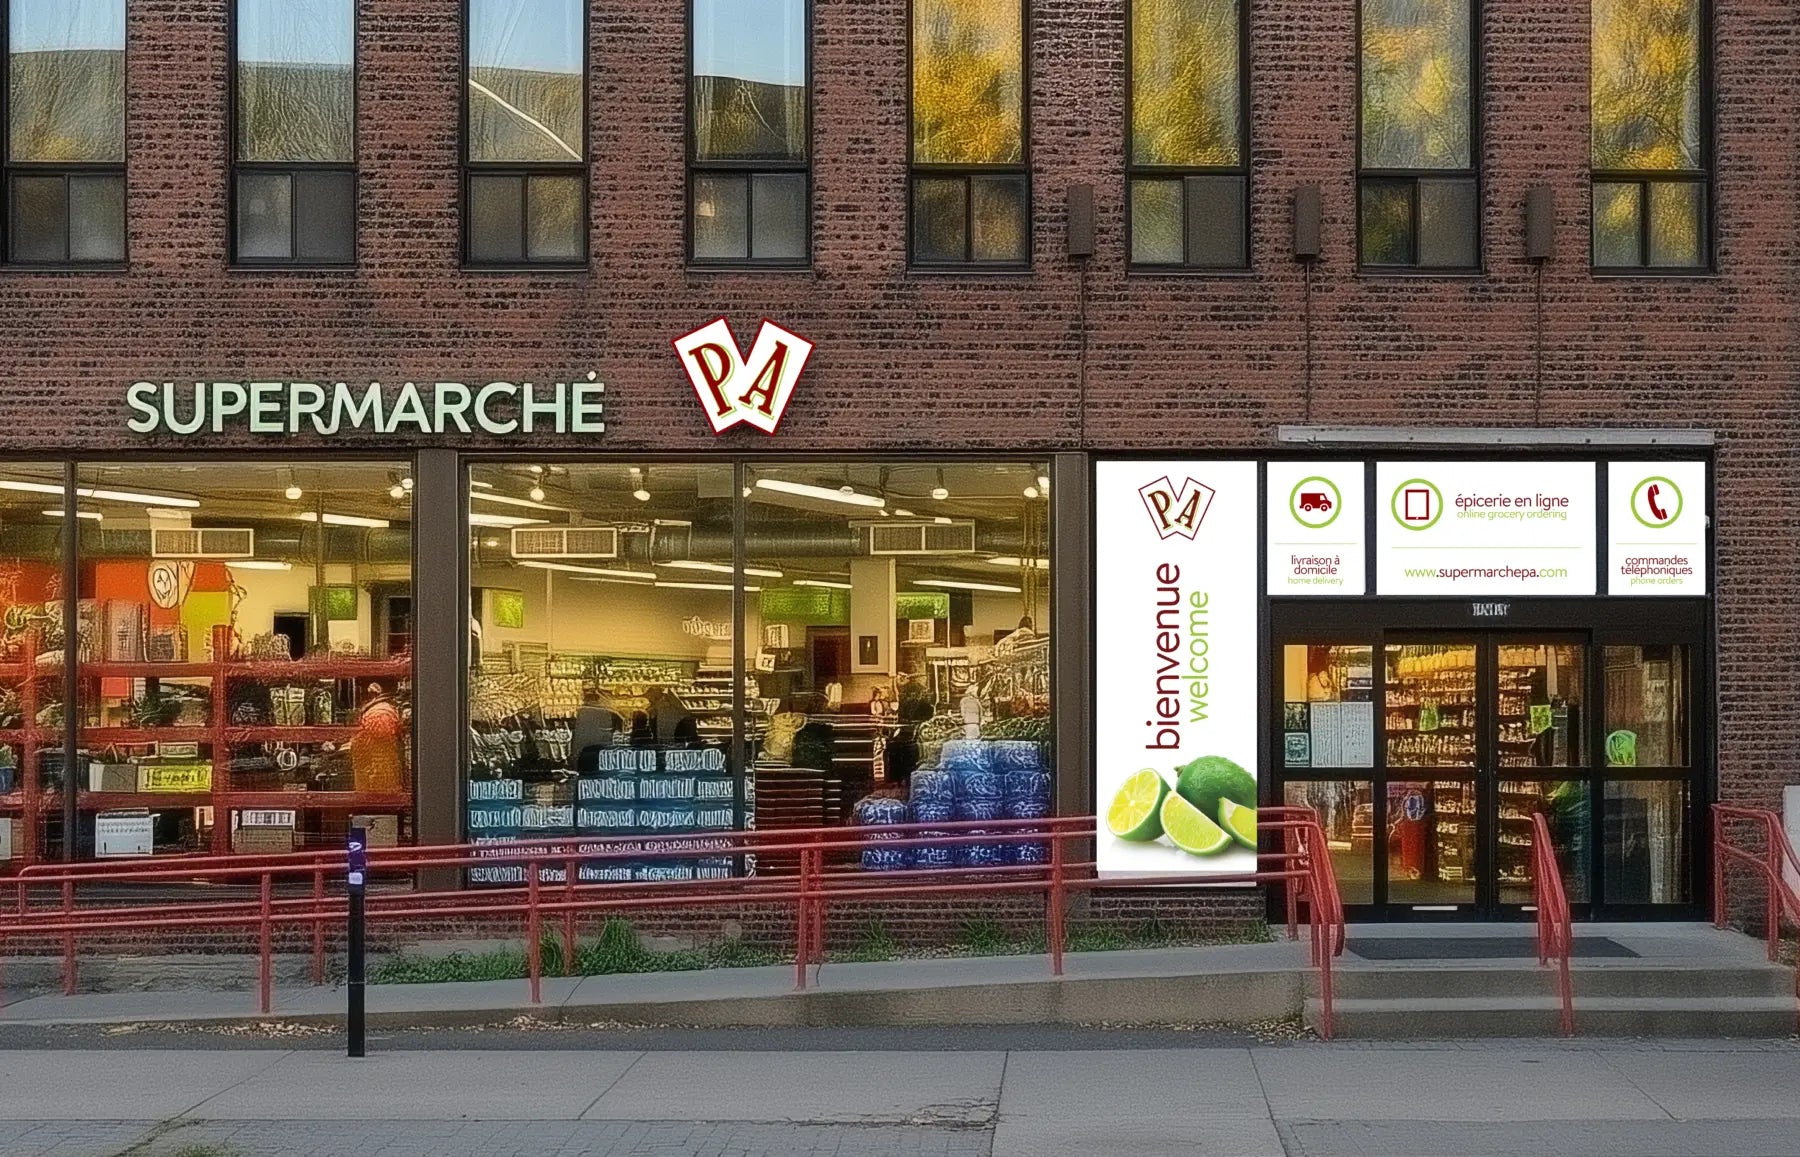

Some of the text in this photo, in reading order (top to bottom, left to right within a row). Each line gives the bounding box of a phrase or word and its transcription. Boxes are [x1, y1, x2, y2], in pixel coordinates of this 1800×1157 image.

[688, 340, 791, 421] PA
[127, 370, 605, 435] SUPERMARCHÉ
[1147, 488, 1202, 531] PA
[1455, 493, 1570, 511] épicerie en ligne
[1457, 509, 1567, 521] online grocery ordering
[1291, 555, 1341, 565] livraison à
[1625, 555, 1689, 565] commandes
[1293, 565, 1338, 575] domicile
[1404, 565, 1568, 582] www.supermarchepa.com
[1621, 565, 1693, 578] téléphoniques
[1288, 576, 1344, 587] home delivery
[1630, 576, 1684, 587] phone orders
[1145, 562, 1181, 750] bienvenue
[1181, 590, 1209, 723] welcome
